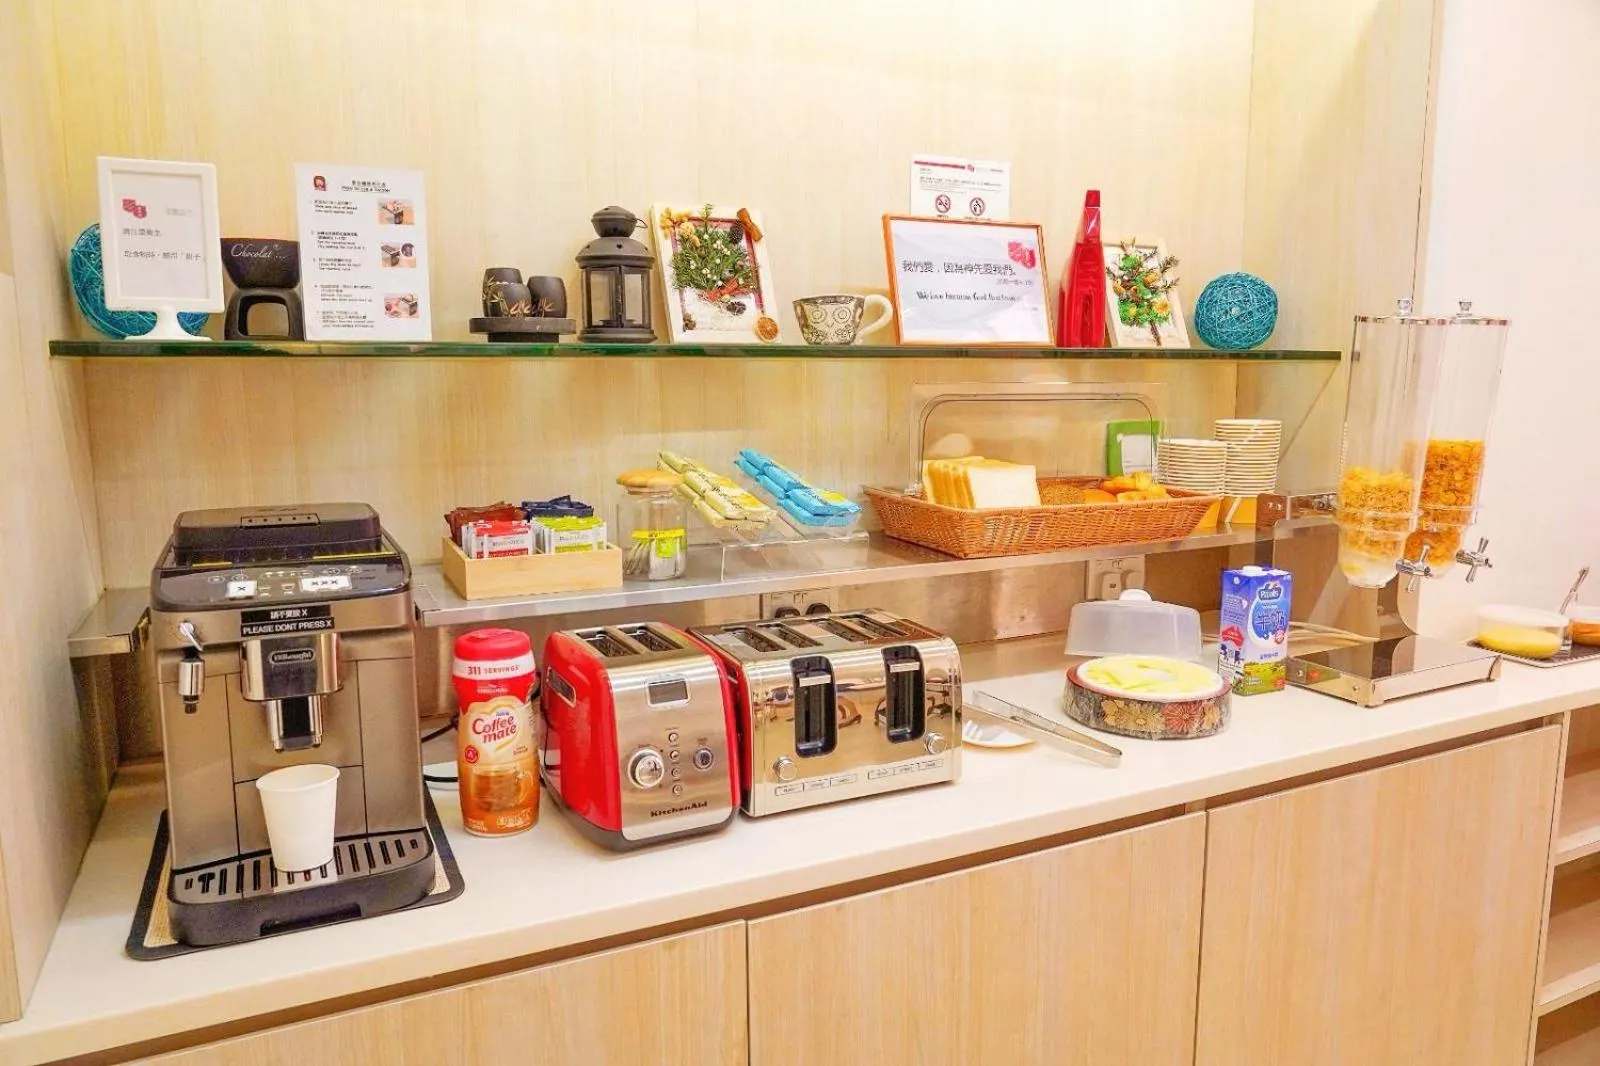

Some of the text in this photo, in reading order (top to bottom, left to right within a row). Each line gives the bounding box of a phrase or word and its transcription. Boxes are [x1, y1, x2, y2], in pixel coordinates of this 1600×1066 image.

[243, 619, 332, 635] PLEASE DONT PRESS X
[467, 664, 520, 675] 311 SERVINGS
[472, 714, 515, 736] Coffee
[482, 723, 517, 745] mate
[650, 801, 708, 817] KitchenAid
